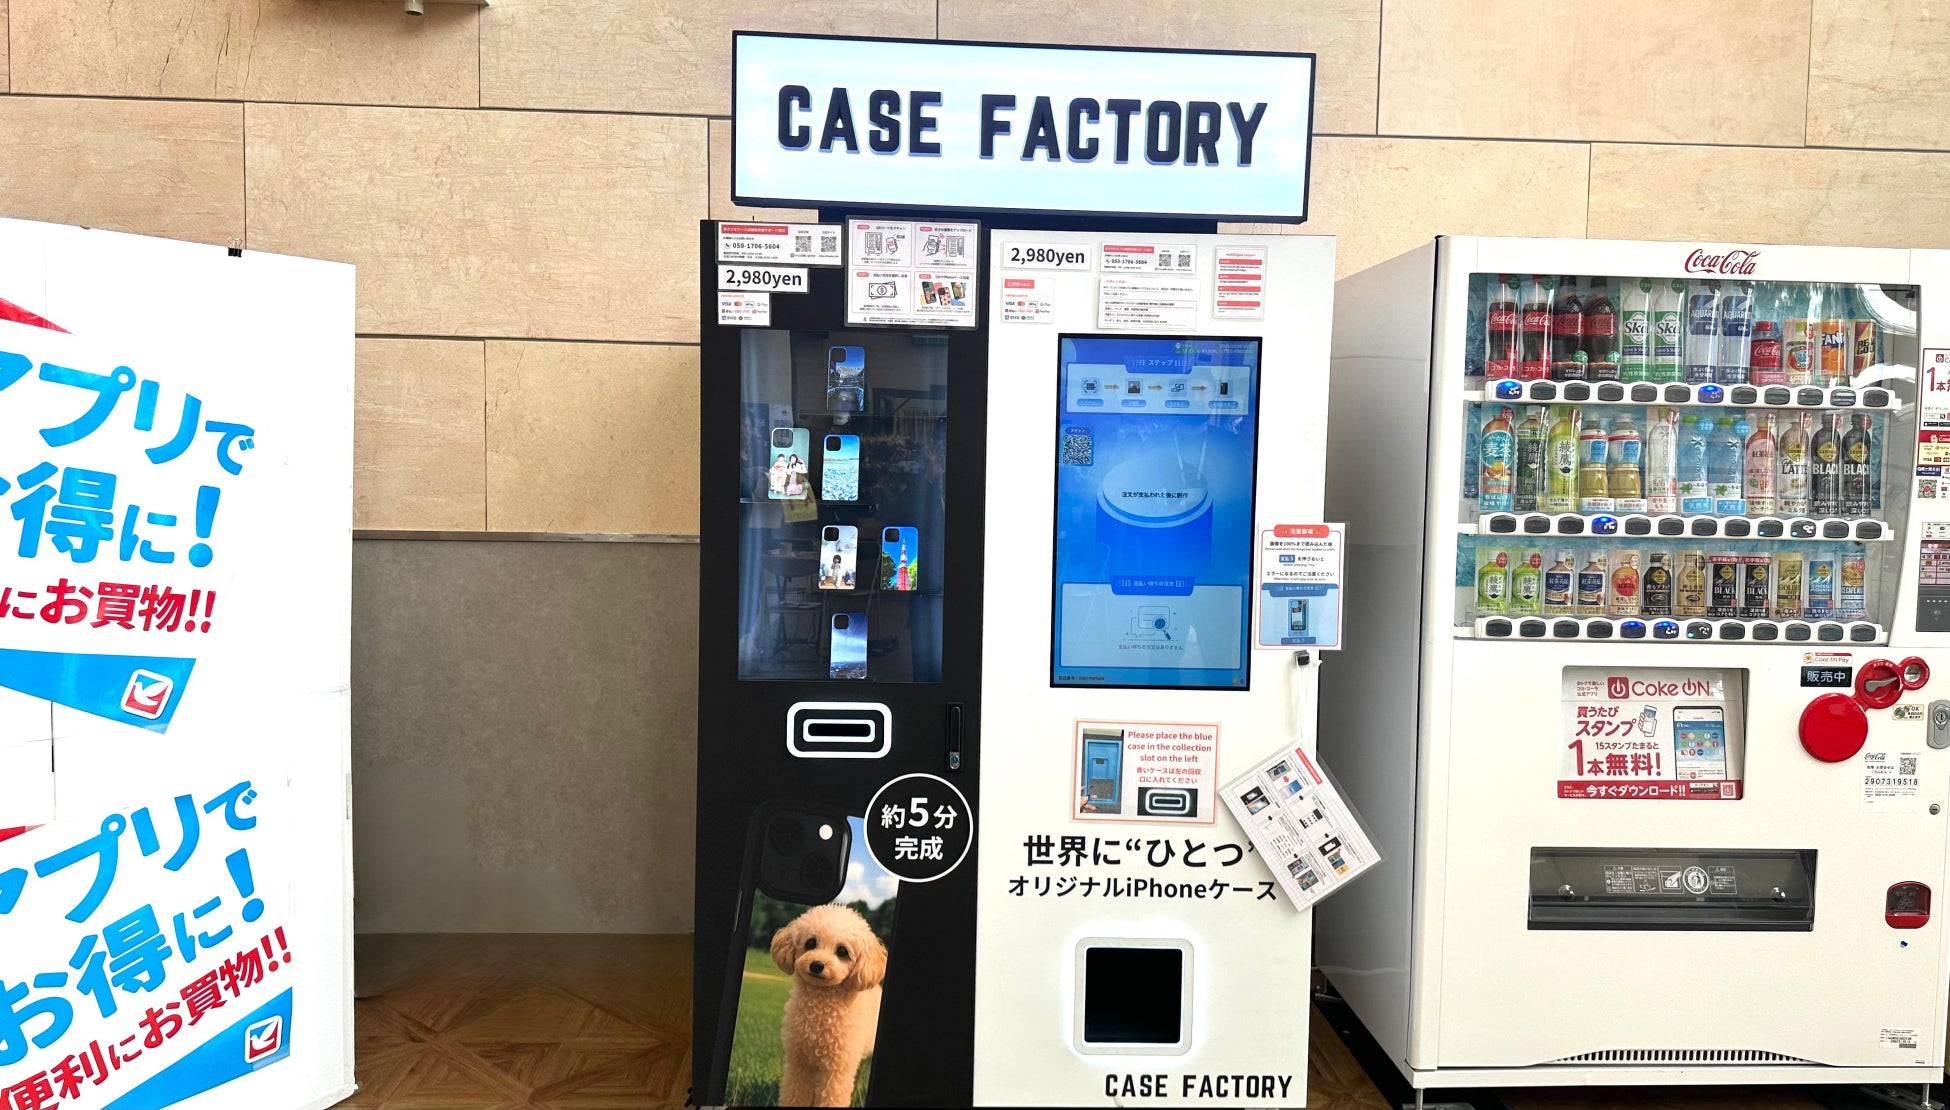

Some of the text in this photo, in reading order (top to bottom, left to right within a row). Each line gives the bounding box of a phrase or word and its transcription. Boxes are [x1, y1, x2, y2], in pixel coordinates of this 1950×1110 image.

[777, 84, 1268, 167] CASE FACTORY
[1011, 248, 1085, 267] 2,980yen
[1684, 249, 1760, 275] Coca-Cola
[726, 270, 801, 288] 2,980yen
[1926, 366, 1950, 392] 1本
[1484, 442, 1511, 457] 麦茶
[1560, 441, 1571, 466] 綾鷹
[0, 462, 221, 567] 得に!
[1807, 671, 1846, 682] 販売中
[1631, 678, 1710, 697] Coke ON
[1576, 706, 1619, 718] 買うたび
[1128, 731, 1212, 740] Please place the blue
[1575, 719, 1636, 737] スタンプ
[1172, 744, 1212, 752] collection
[1595, 742, 1659, 750] 15スタンプたまると
[1140, 754, 1155, 762] slot
[1184, 755, 1198, 763] left
[1568, 739, 1661, 776] 1本無料!
[1137, 767, 1201, 775] 青いケースは左の回収
[1586, 784, 1686, 797] 今すぐダウンロード!!
[881, 797, 958, 829] 約5分
[894, 836, 943, 860] 完成
[1008, 875, 1277, 900] オリジナルiPhoneケース
[1105, 1074, 1293, 1098] CASE FACTORY
